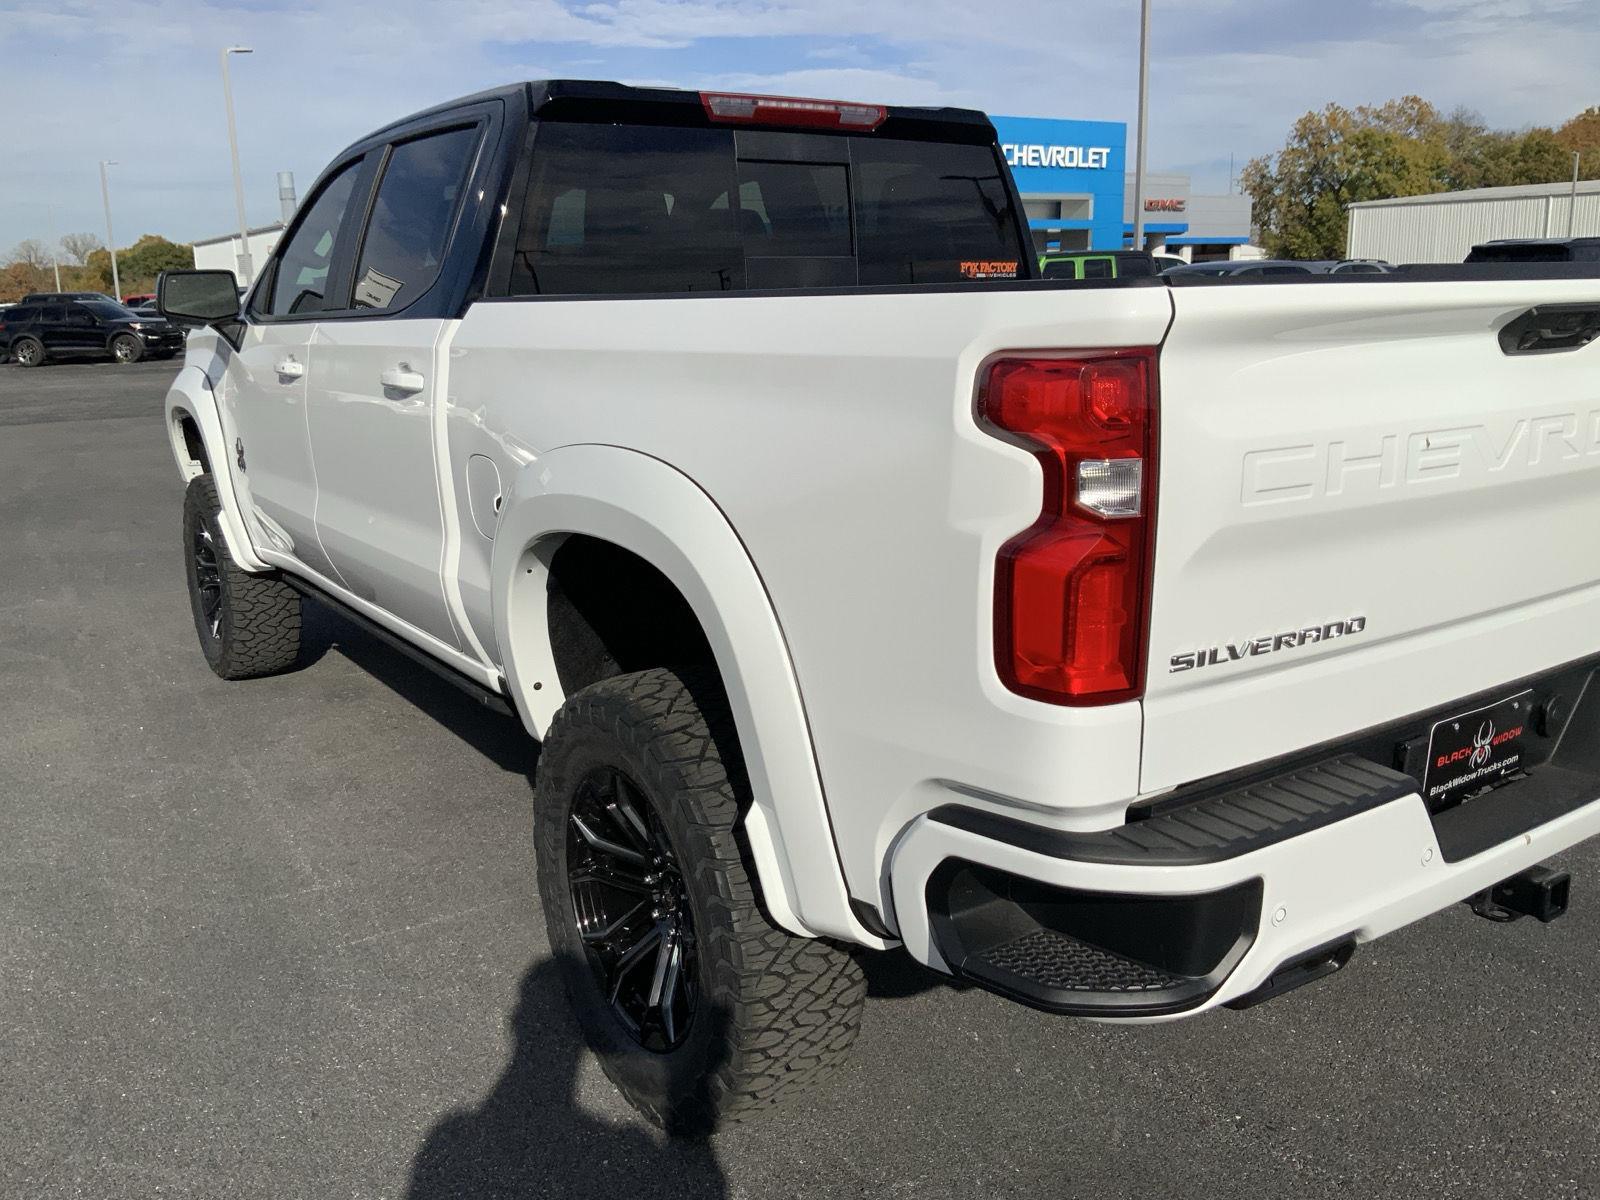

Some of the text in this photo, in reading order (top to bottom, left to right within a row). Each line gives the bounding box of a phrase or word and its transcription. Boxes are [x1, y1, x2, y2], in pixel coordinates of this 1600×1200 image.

[1001, 143, 1111, 169] CHEVROLET
[1144, 199, 1186, 213] GMC
[960, 261, 1018, 274] FOX FACTORY
[1169, 615, 1367, 674] SILVERADO
[1436, 725, 1524, 768] BLACK WIDOW
[1429, 754, 1519, 797] BlackWidowTrucks.com
